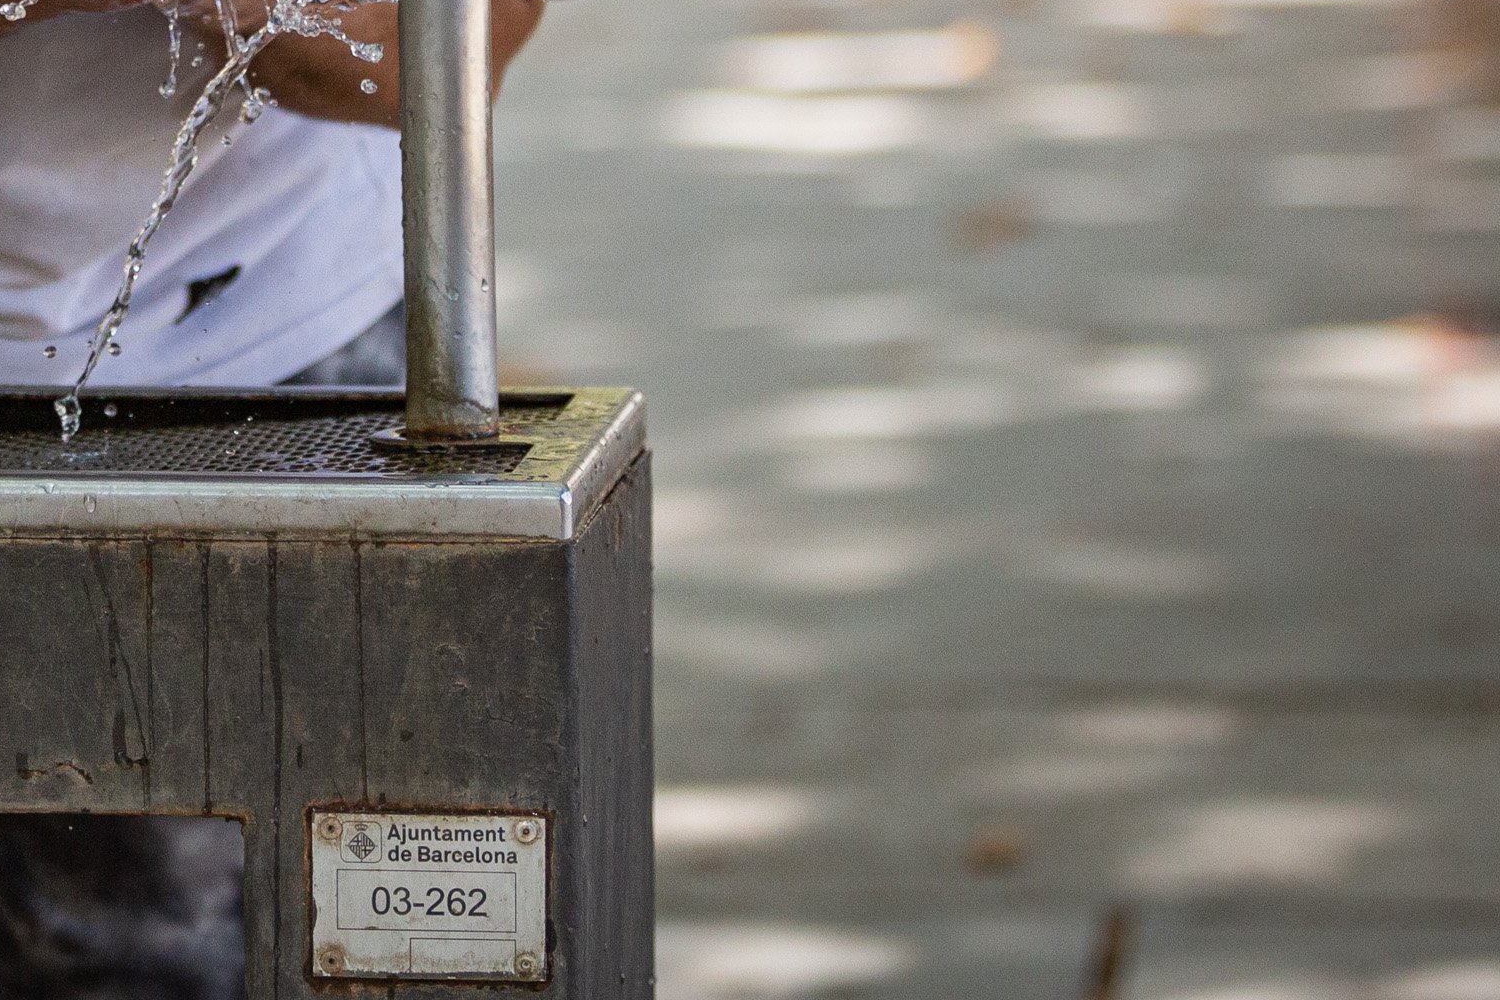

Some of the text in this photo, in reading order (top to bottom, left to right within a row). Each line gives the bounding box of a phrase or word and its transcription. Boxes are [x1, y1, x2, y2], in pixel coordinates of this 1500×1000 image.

[387, 824, 506, 845] Ajuntament
[387, 846, 518, 864] de Barcelona
[371, 886, 488, 917] 03-262
